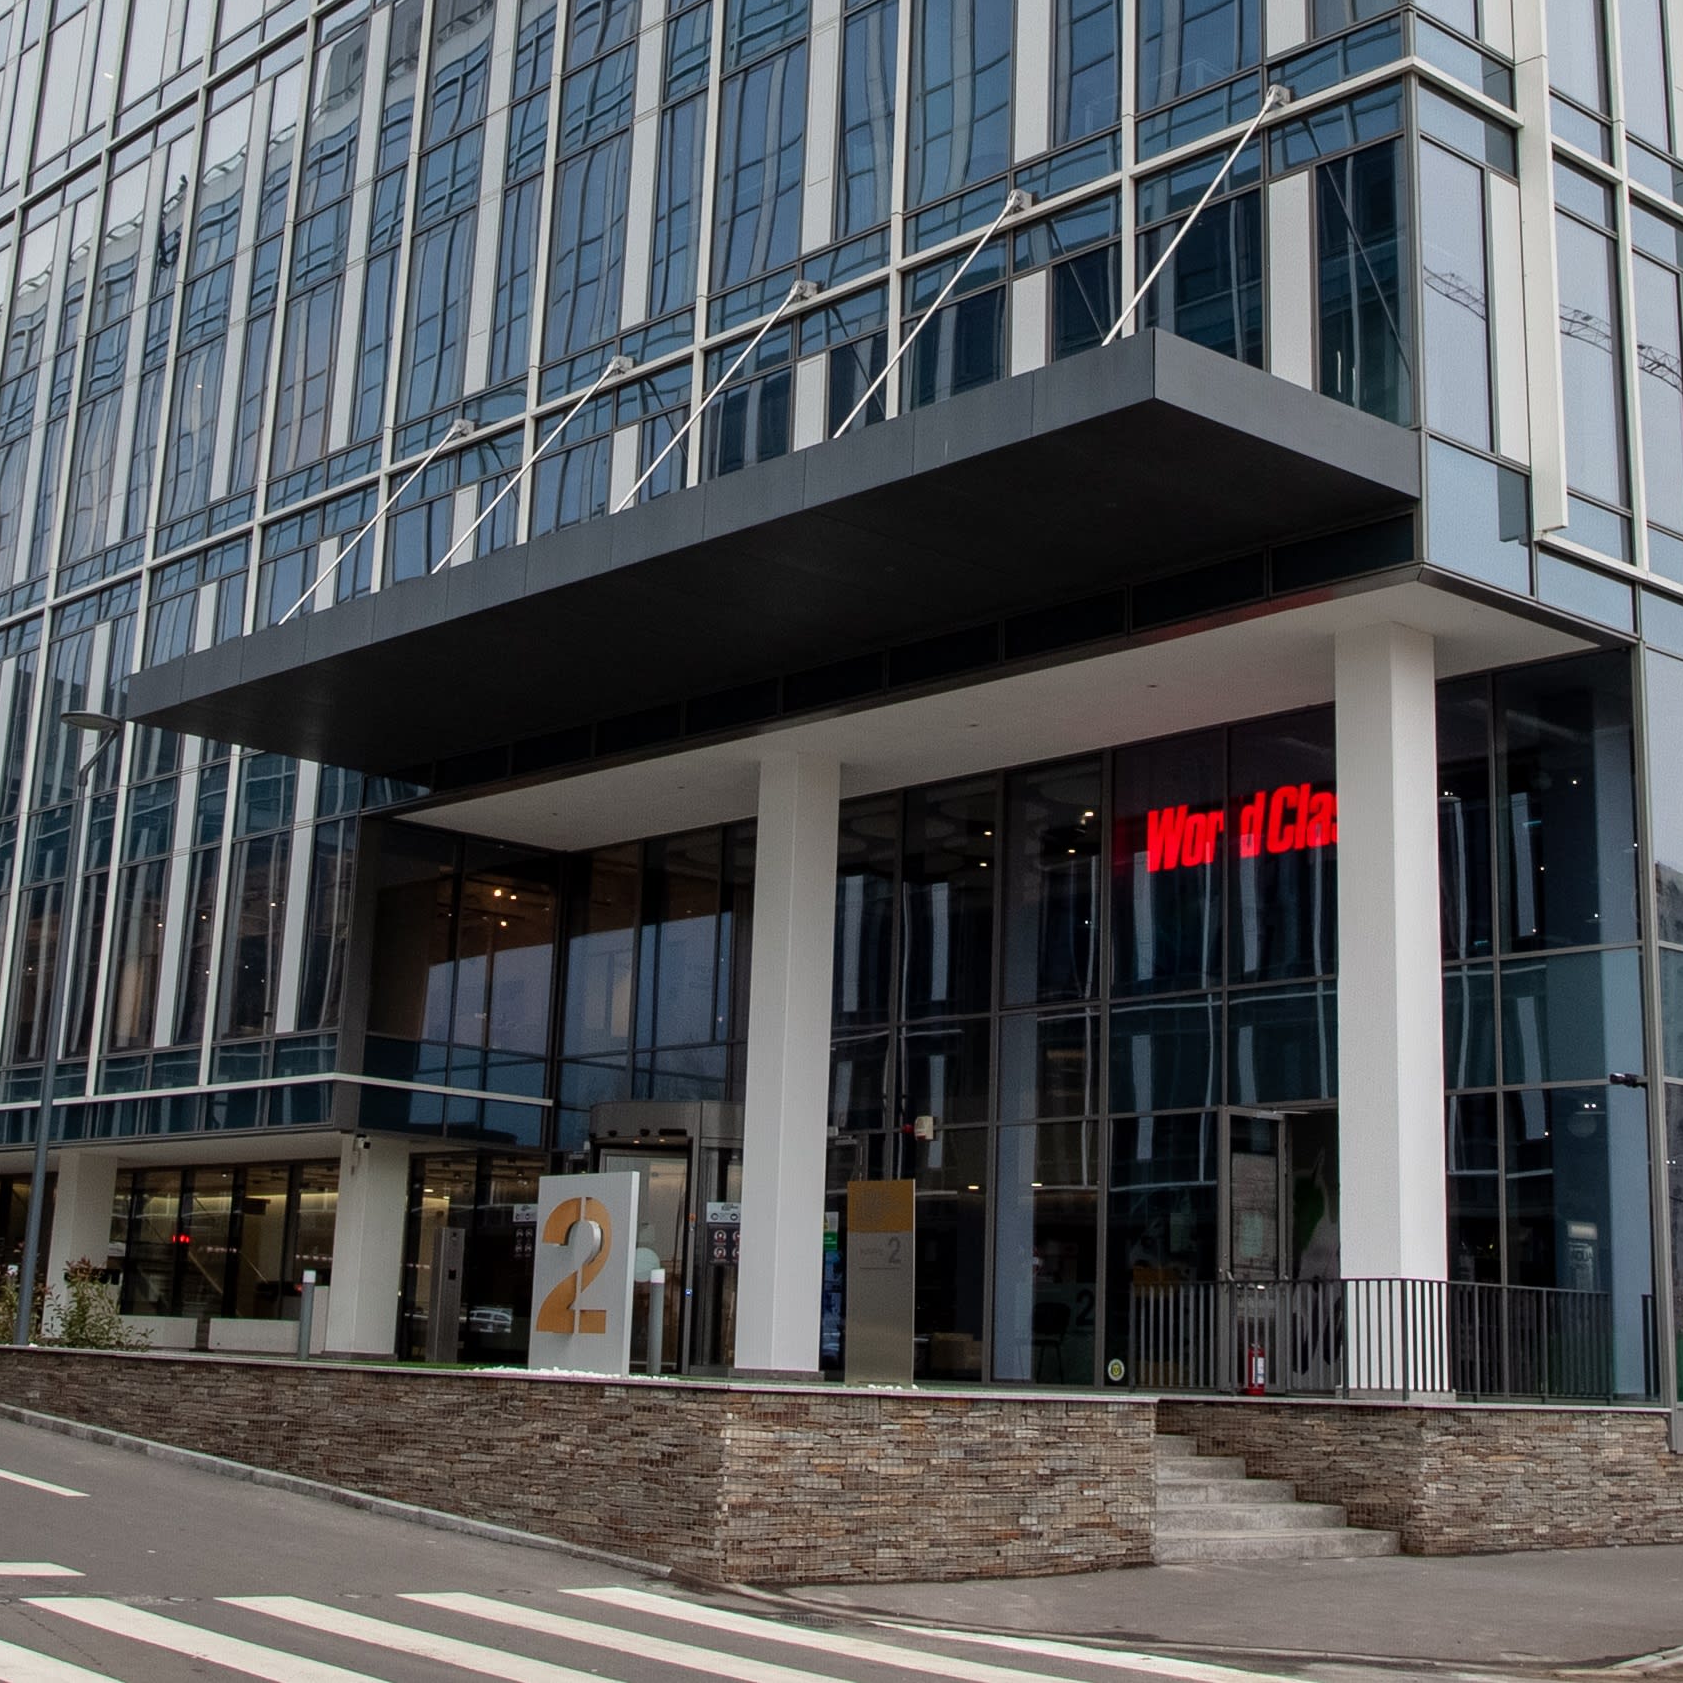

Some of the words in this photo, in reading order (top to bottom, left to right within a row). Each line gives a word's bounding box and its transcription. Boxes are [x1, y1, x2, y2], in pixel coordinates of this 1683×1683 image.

[1147, 791, 1266, 872] Word
[1267, 783, 1338, 854] Cla
[536, 1197, 612, 1334] 2
[888, 1236, 902, 1264] 2
